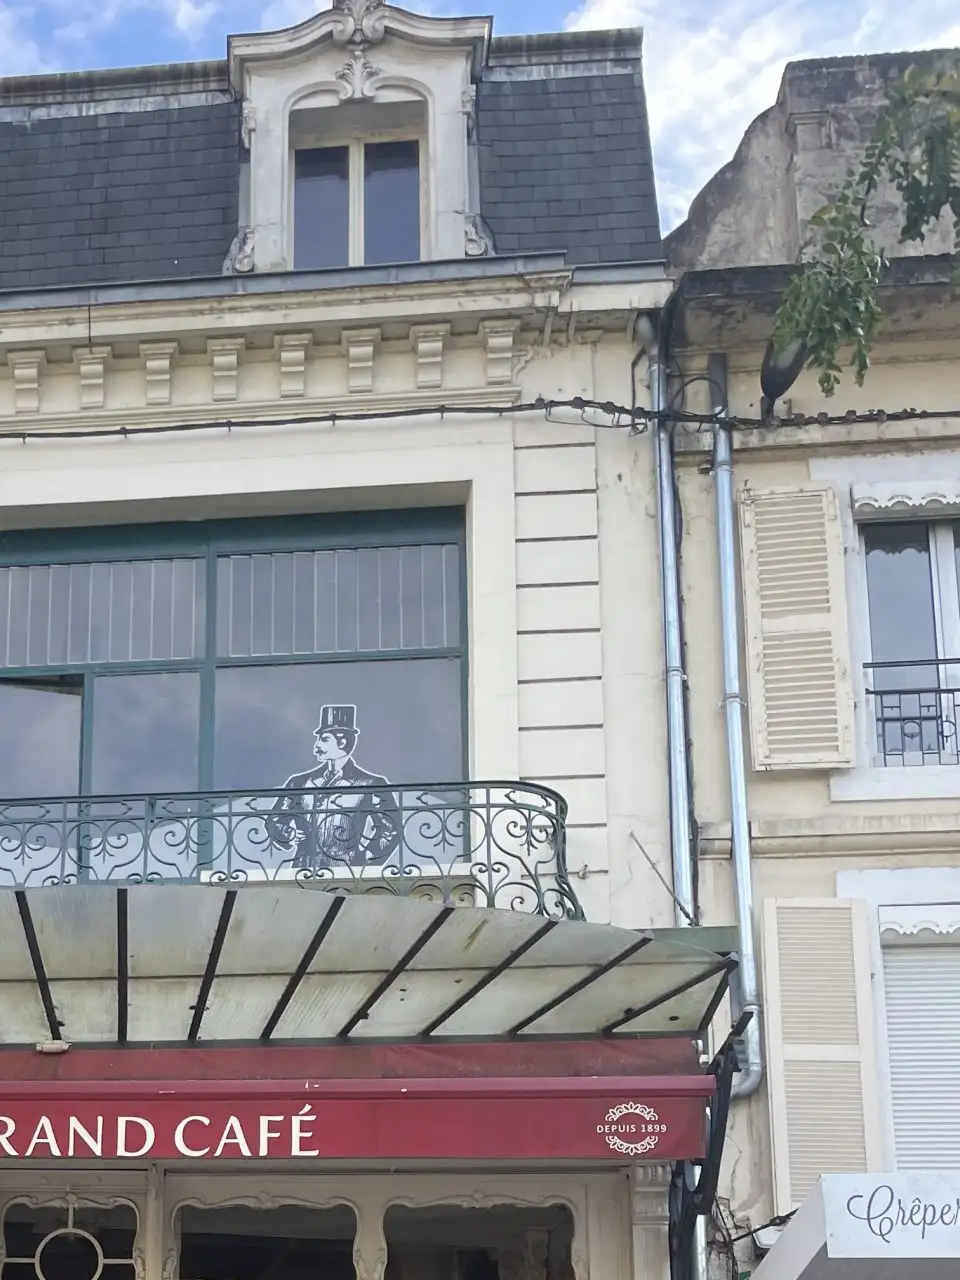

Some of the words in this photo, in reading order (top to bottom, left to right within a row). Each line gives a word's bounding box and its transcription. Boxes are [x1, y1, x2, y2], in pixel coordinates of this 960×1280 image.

[174, 1103, 320, 1157] CAFÉ
[596, 1124, 636, 1134] DEPUIS
[641, 1124, 667, 1133] 1899
